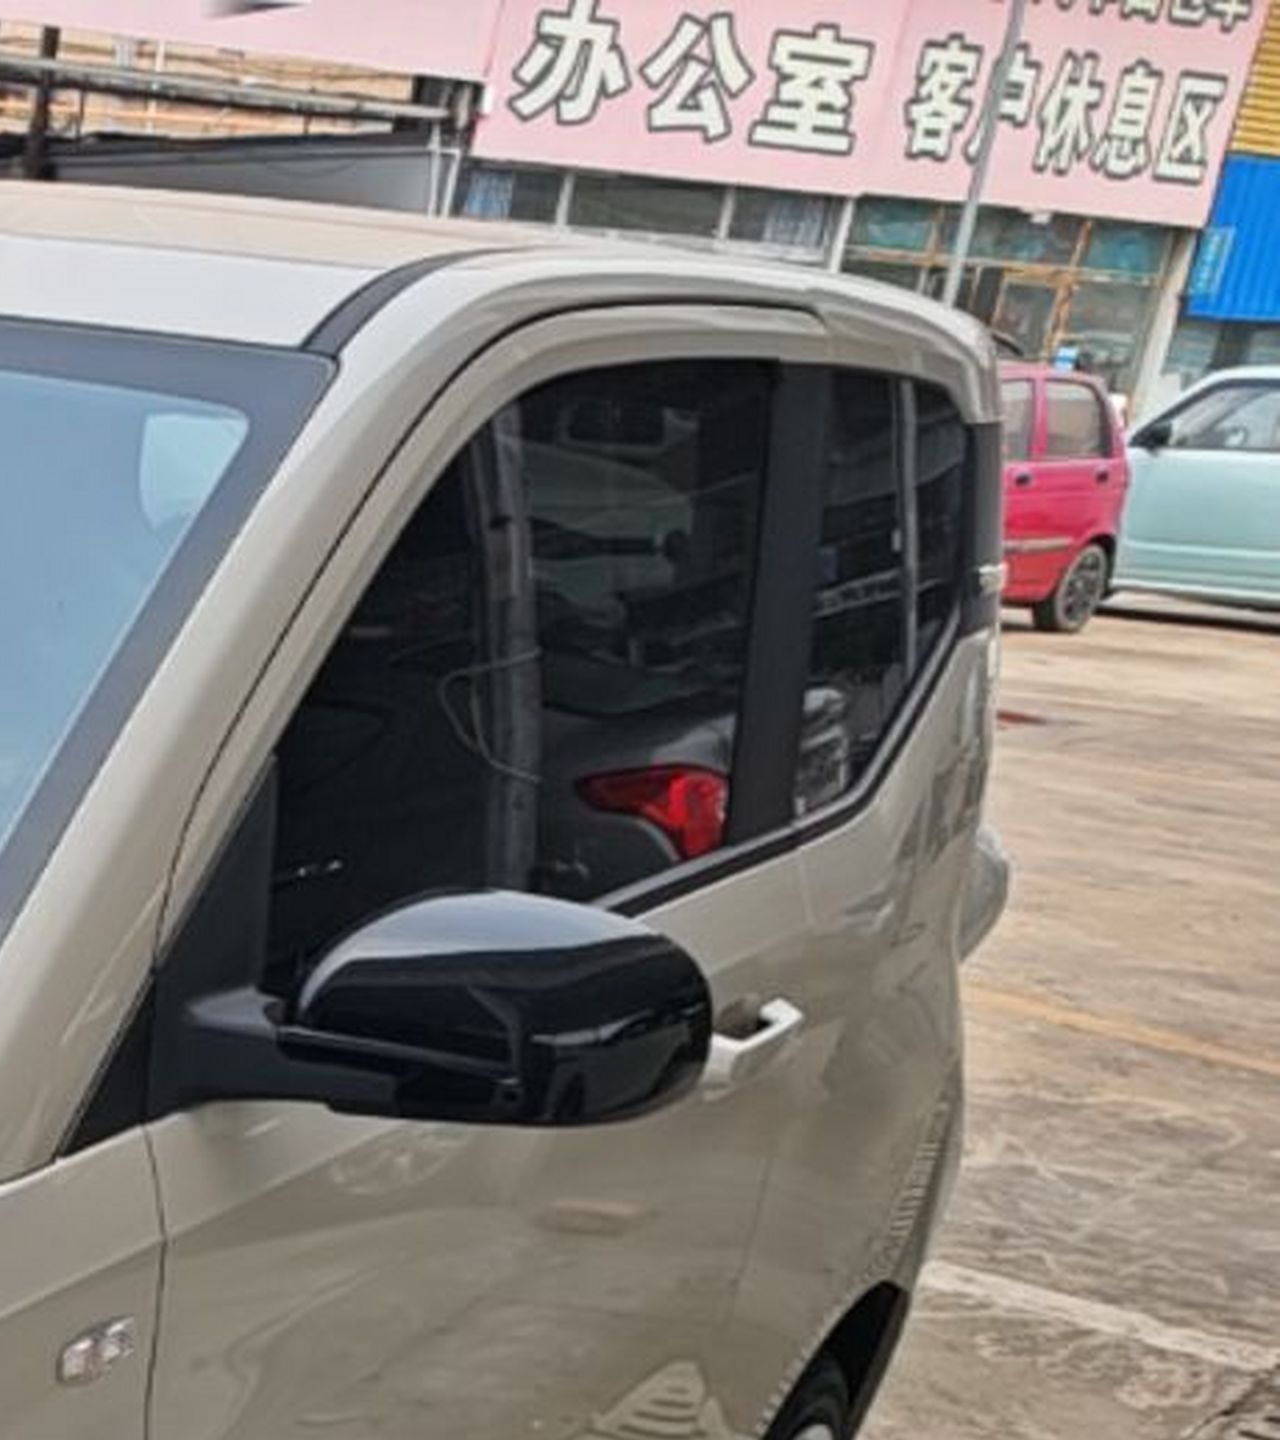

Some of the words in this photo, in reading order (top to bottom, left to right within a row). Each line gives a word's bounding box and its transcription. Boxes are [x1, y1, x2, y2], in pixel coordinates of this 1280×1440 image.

[508, 0, 876, 156] 办公室
[904, 33, 1228, 187] 客户休息区
